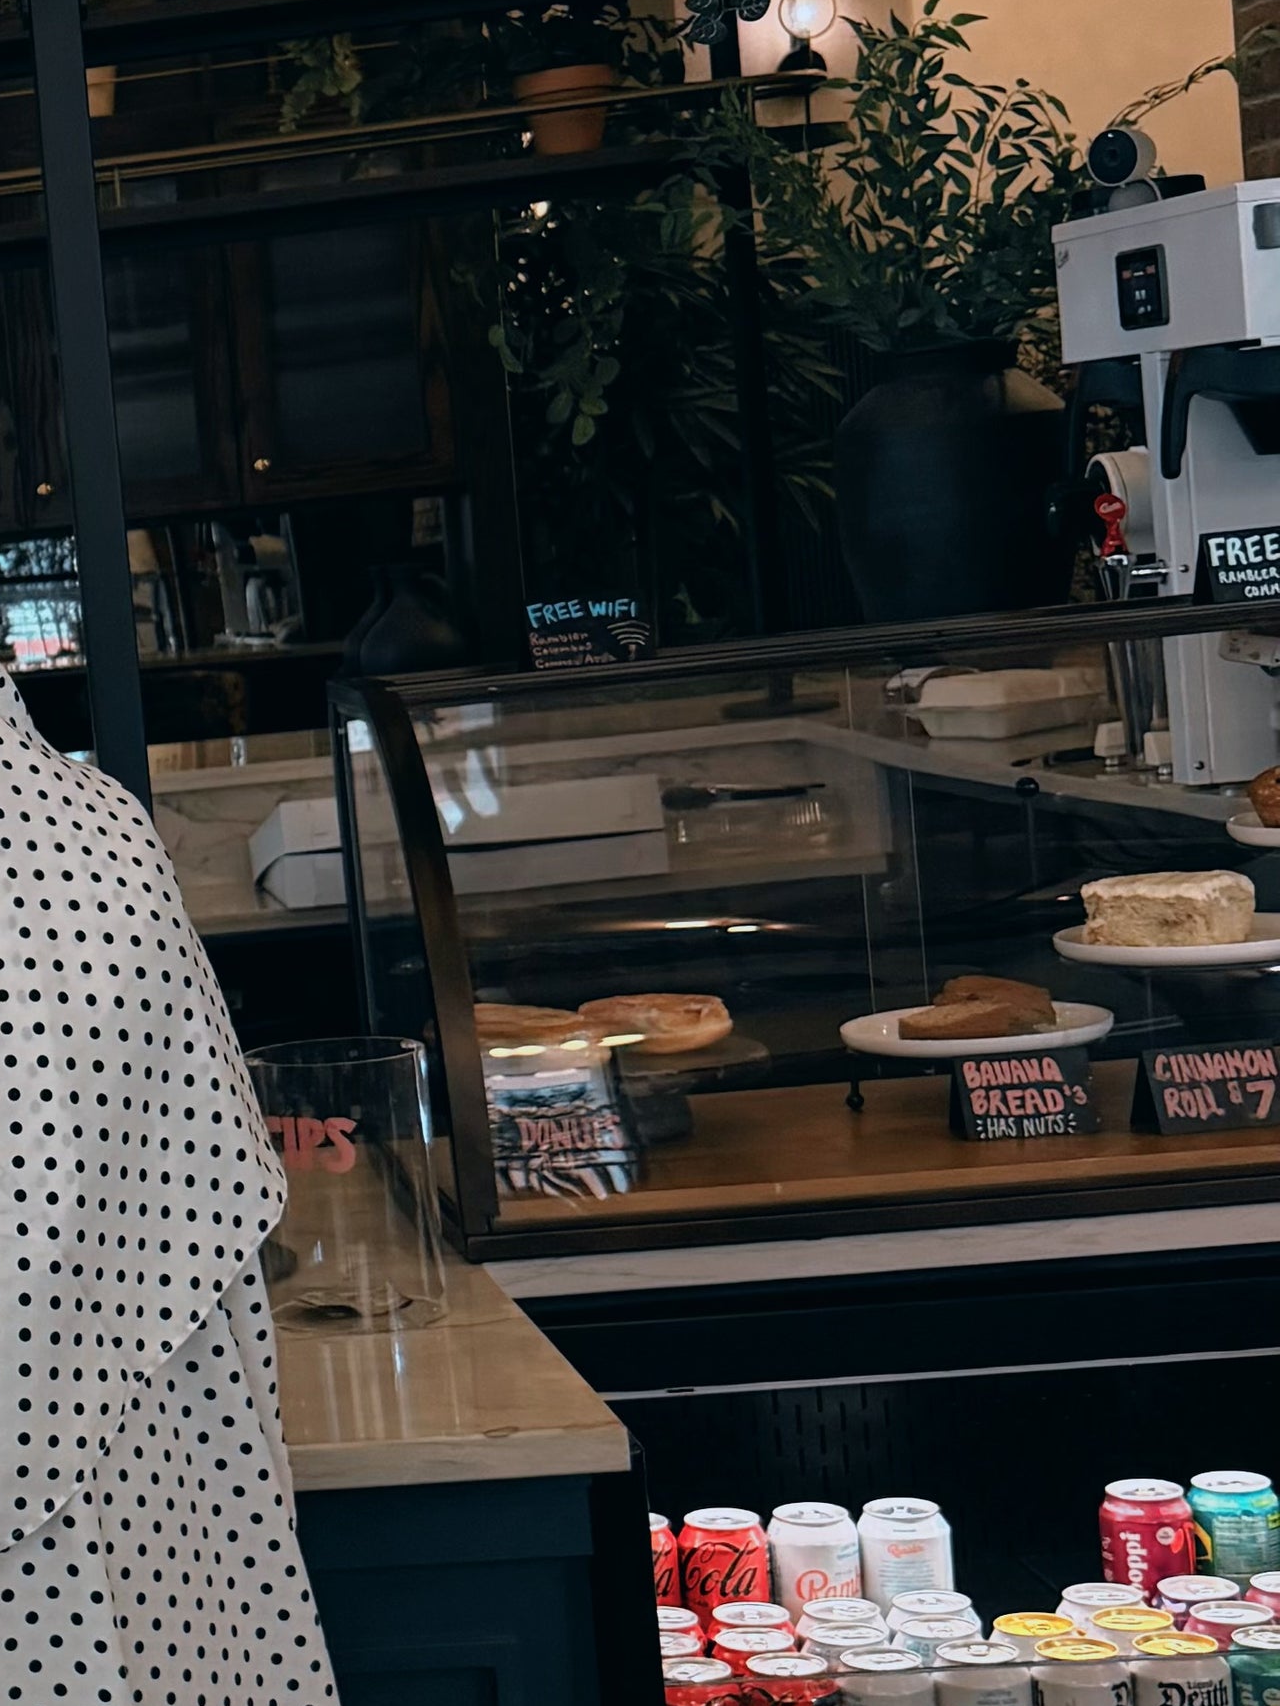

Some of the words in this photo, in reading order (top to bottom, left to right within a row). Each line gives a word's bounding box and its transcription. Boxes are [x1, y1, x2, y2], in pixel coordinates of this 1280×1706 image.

[1207, 533, 1280, 567] FREE
[526, 599, 584, 628] FREE
[962, 1056, 1065, 1089] BANANA
[1154, 1048, 1278, 1083] CINNAMON
[970, 1087, 1066, 1116] BREAD
[1164, 1084, 1226, 1120] ROLL
[987, 1116, 1017, 1139] HAS
[1023, 1114, 1066, 1135] NUTS
[682, 1541, 758, 1597] Cola
